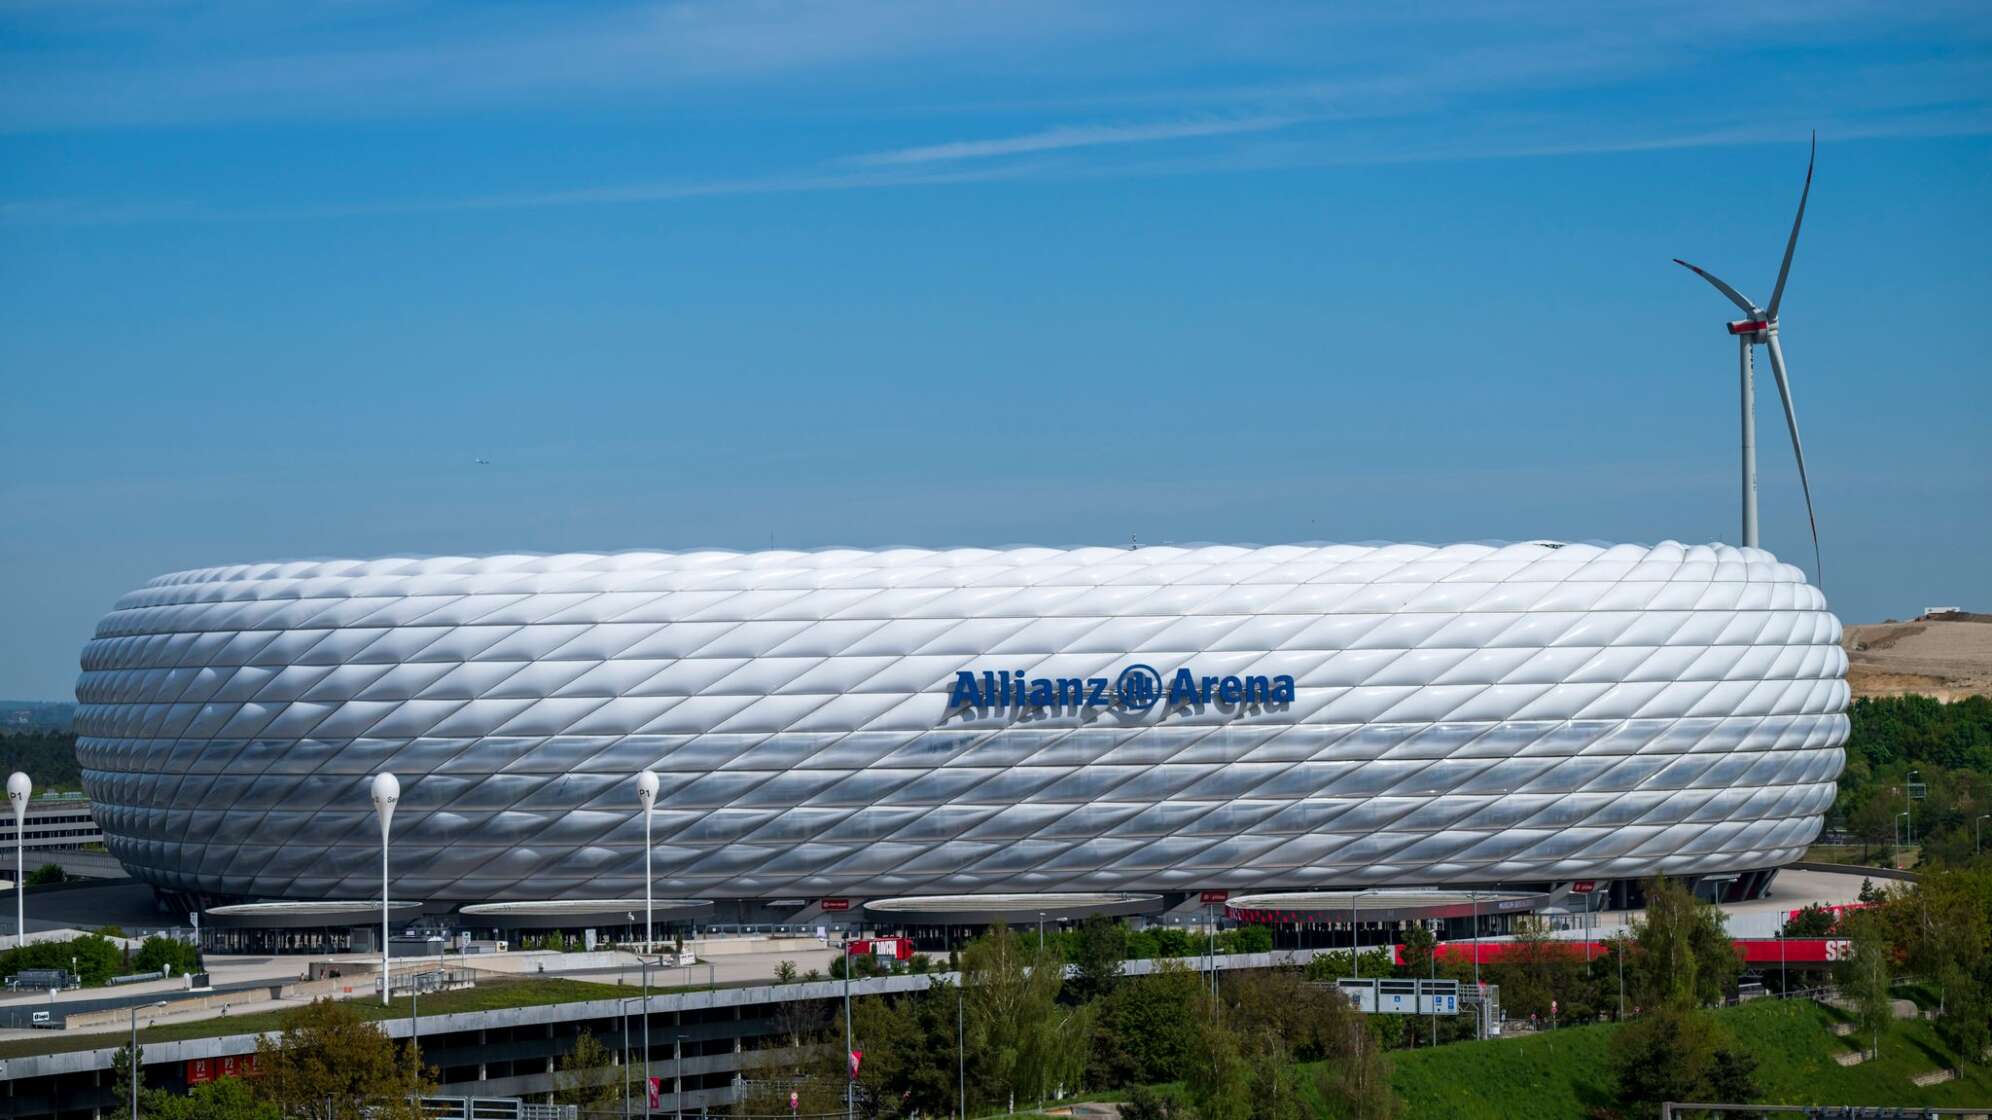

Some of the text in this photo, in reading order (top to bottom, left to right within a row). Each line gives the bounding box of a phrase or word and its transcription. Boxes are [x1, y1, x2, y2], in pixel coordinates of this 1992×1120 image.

[950, 667, 1296, 708] Allianz Arena
[10, 791, 23, 801] P1
[639, 788, 650, 798] P1
